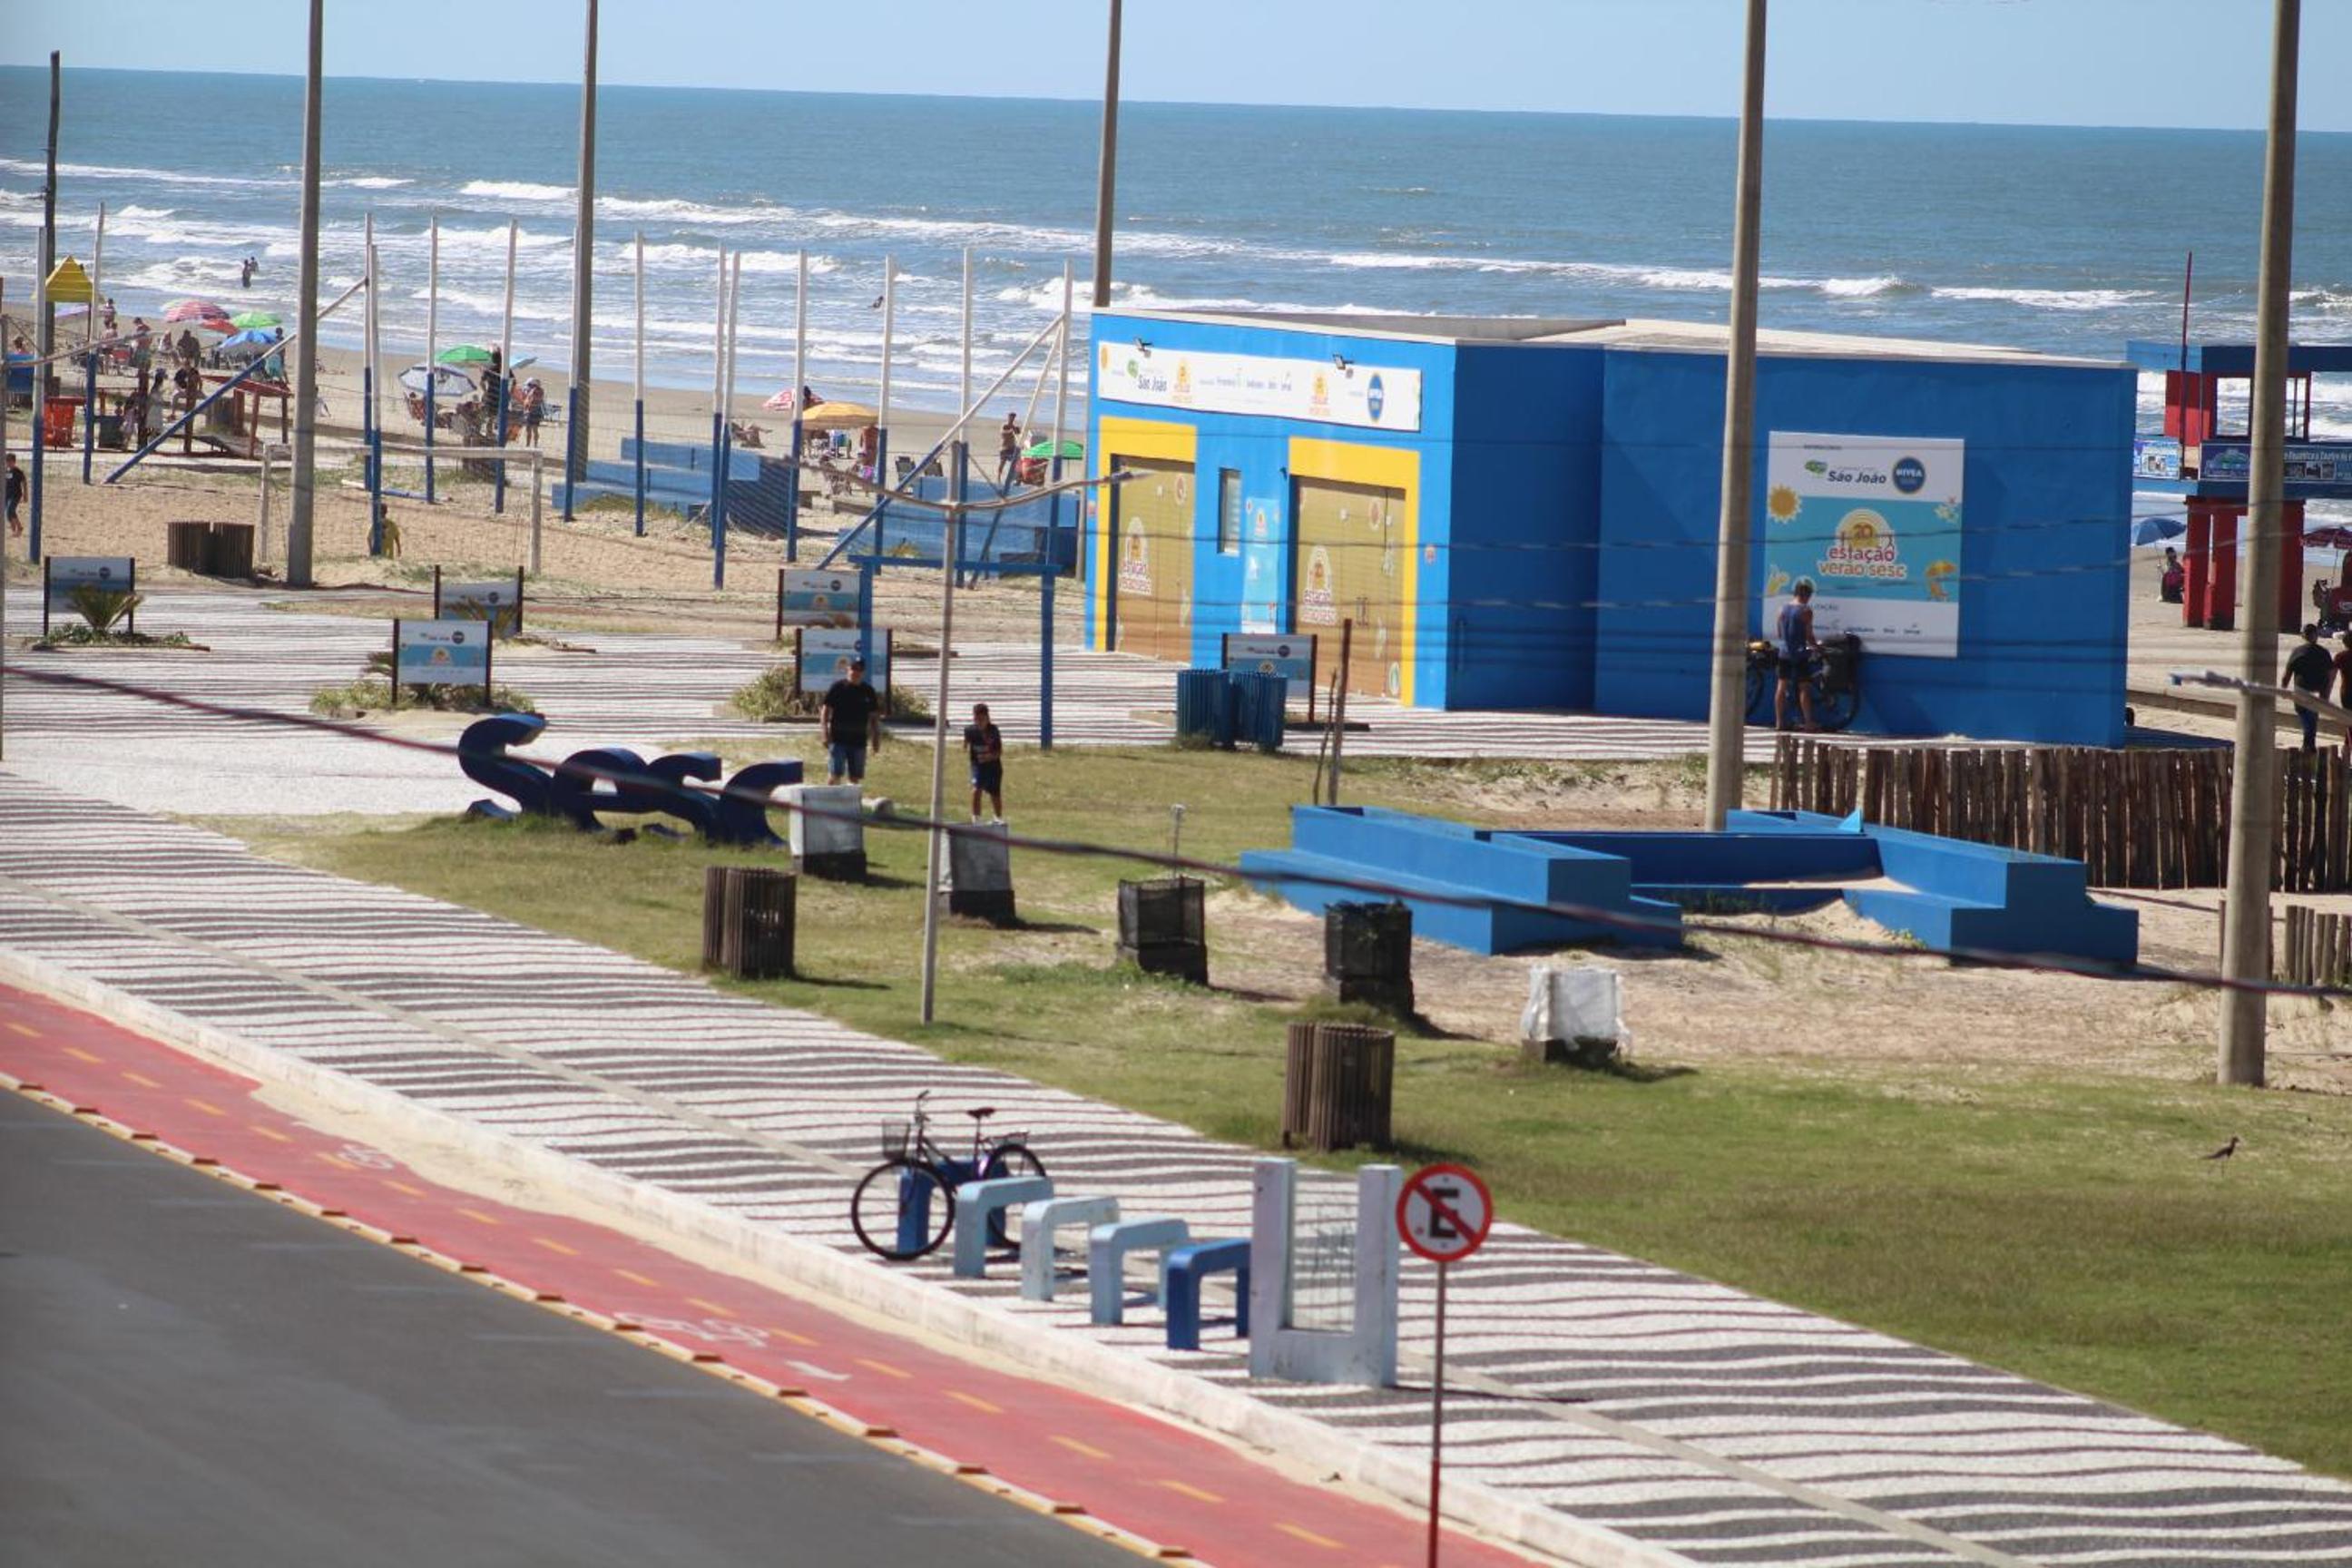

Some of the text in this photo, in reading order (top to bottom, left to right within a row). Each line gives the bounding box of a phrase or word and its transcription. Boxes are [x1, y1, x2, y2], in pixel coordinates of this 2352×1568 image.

[1827, 471, 1852, 483] São
[1855, 471, 1886, 485] João
[1896, 468, 1923, 477] NIVEA
[1828, 546, 1895, 564] estação
[1820, 562, 1905, 577] verão sesc
[1430, 1189, 1458, 1238] E
